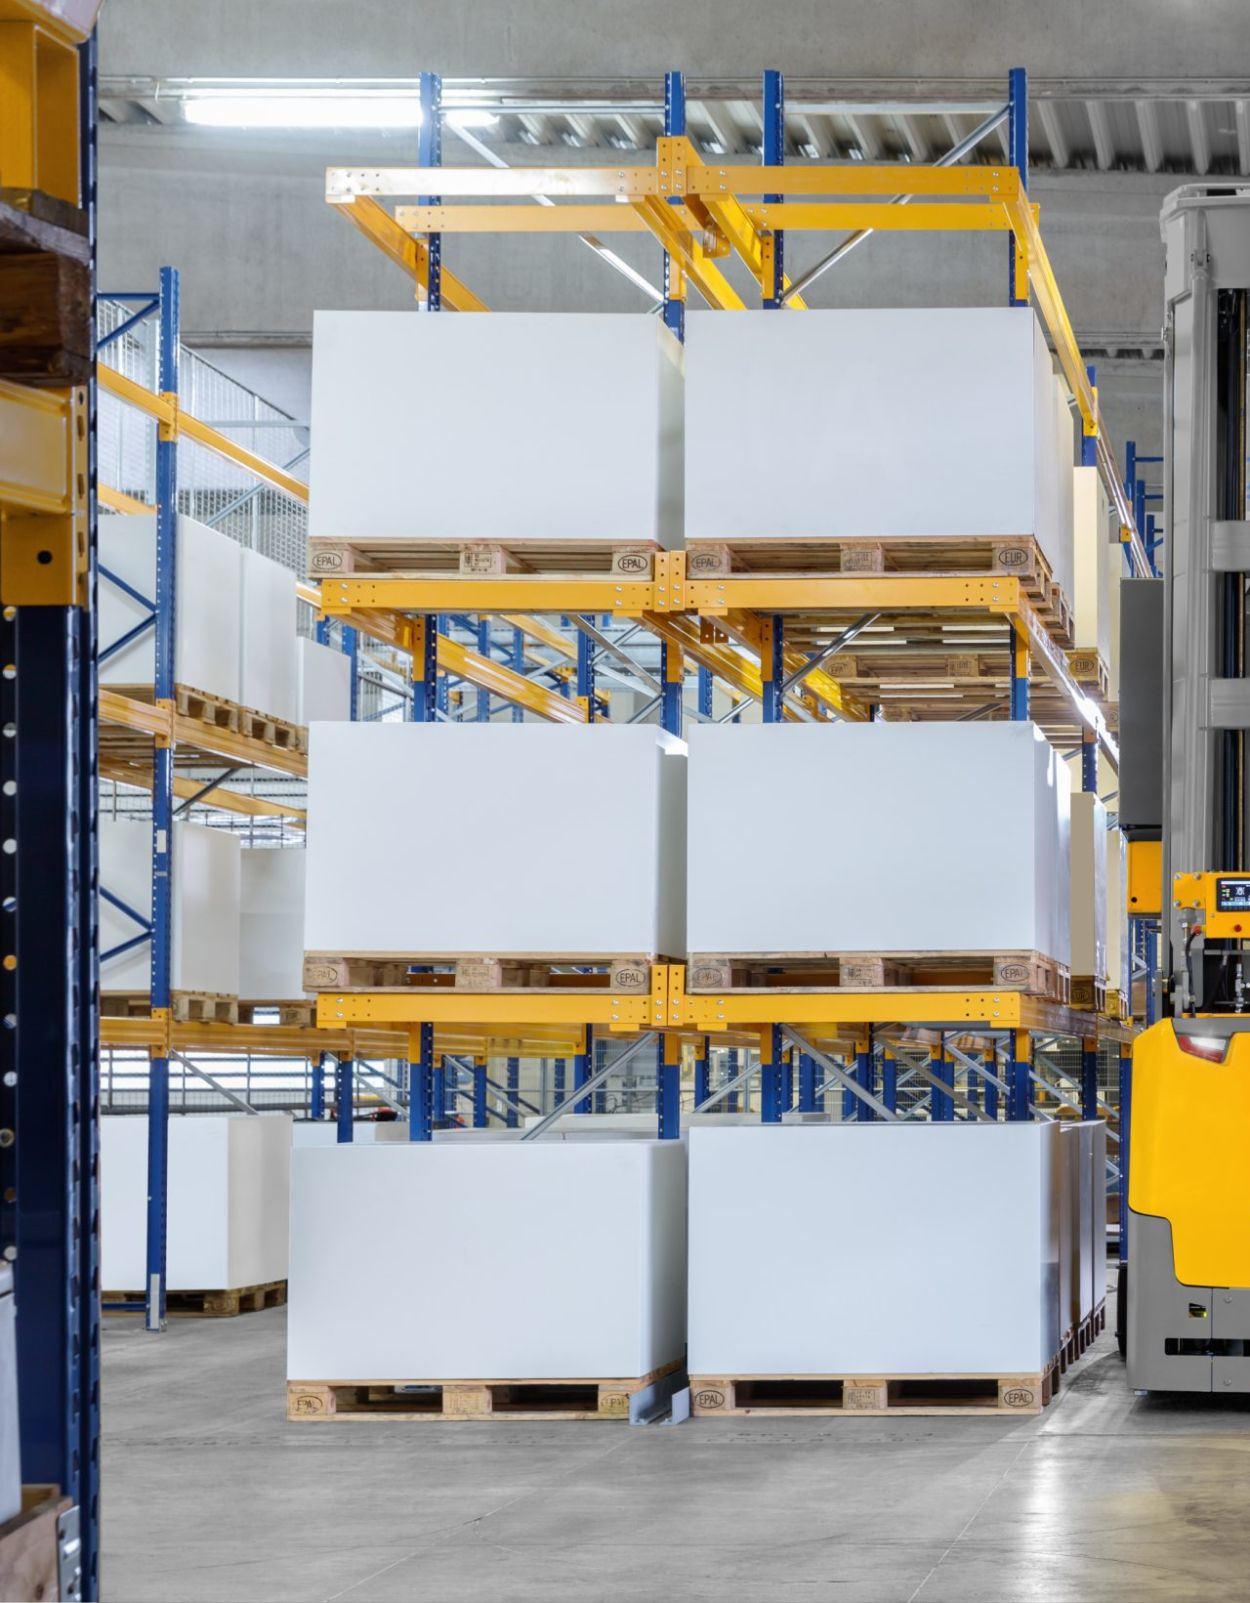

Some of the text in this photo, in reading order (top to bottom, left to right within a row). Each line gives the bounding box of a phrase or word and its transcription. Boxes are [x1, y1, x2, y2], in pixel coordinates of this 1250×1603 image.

[316, 556, 337, 567] EPAL
[696, 557, 715, 568] EPAL
[1004, 551, 1022, 563] EUR
[622, 558, 642, 570] EPAL
[620, 972, 640, 983] EPAL
[699, 1394, 719, 1405] EPAL
[1008, 1393, 1028, 1404] EPAL
